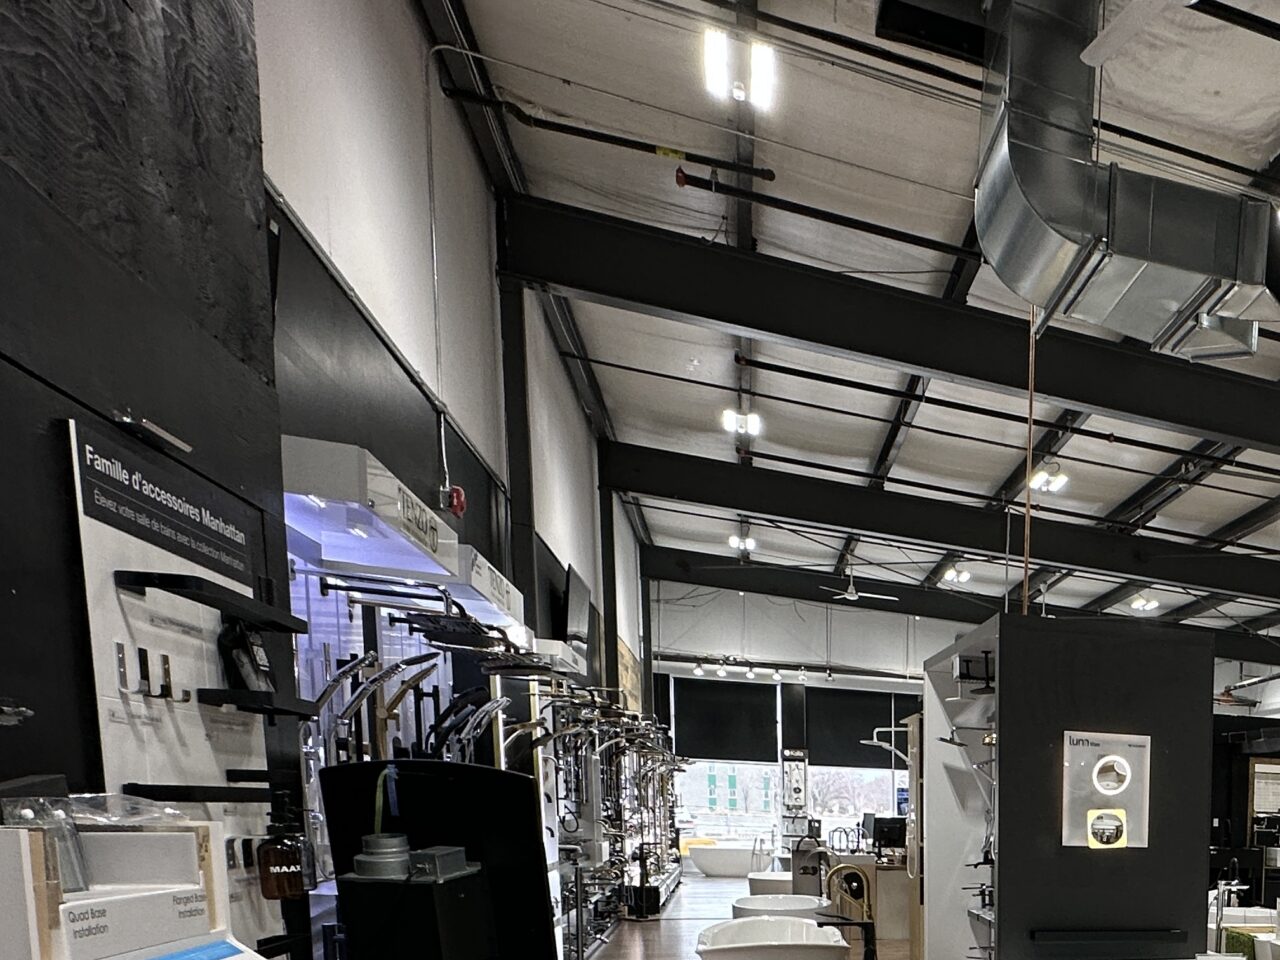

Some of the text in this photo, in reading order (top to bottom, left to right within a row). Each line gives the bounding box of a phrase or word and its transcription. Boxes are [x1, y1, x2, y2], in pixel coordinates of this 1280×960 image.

[85, 444, 246, 545] Famille d'accessoires Manhattan
[269, 865, 301, 873] MAAX
[68, 907, 107, 923] Quad Base
[72, 923, 108, 939] Installation
